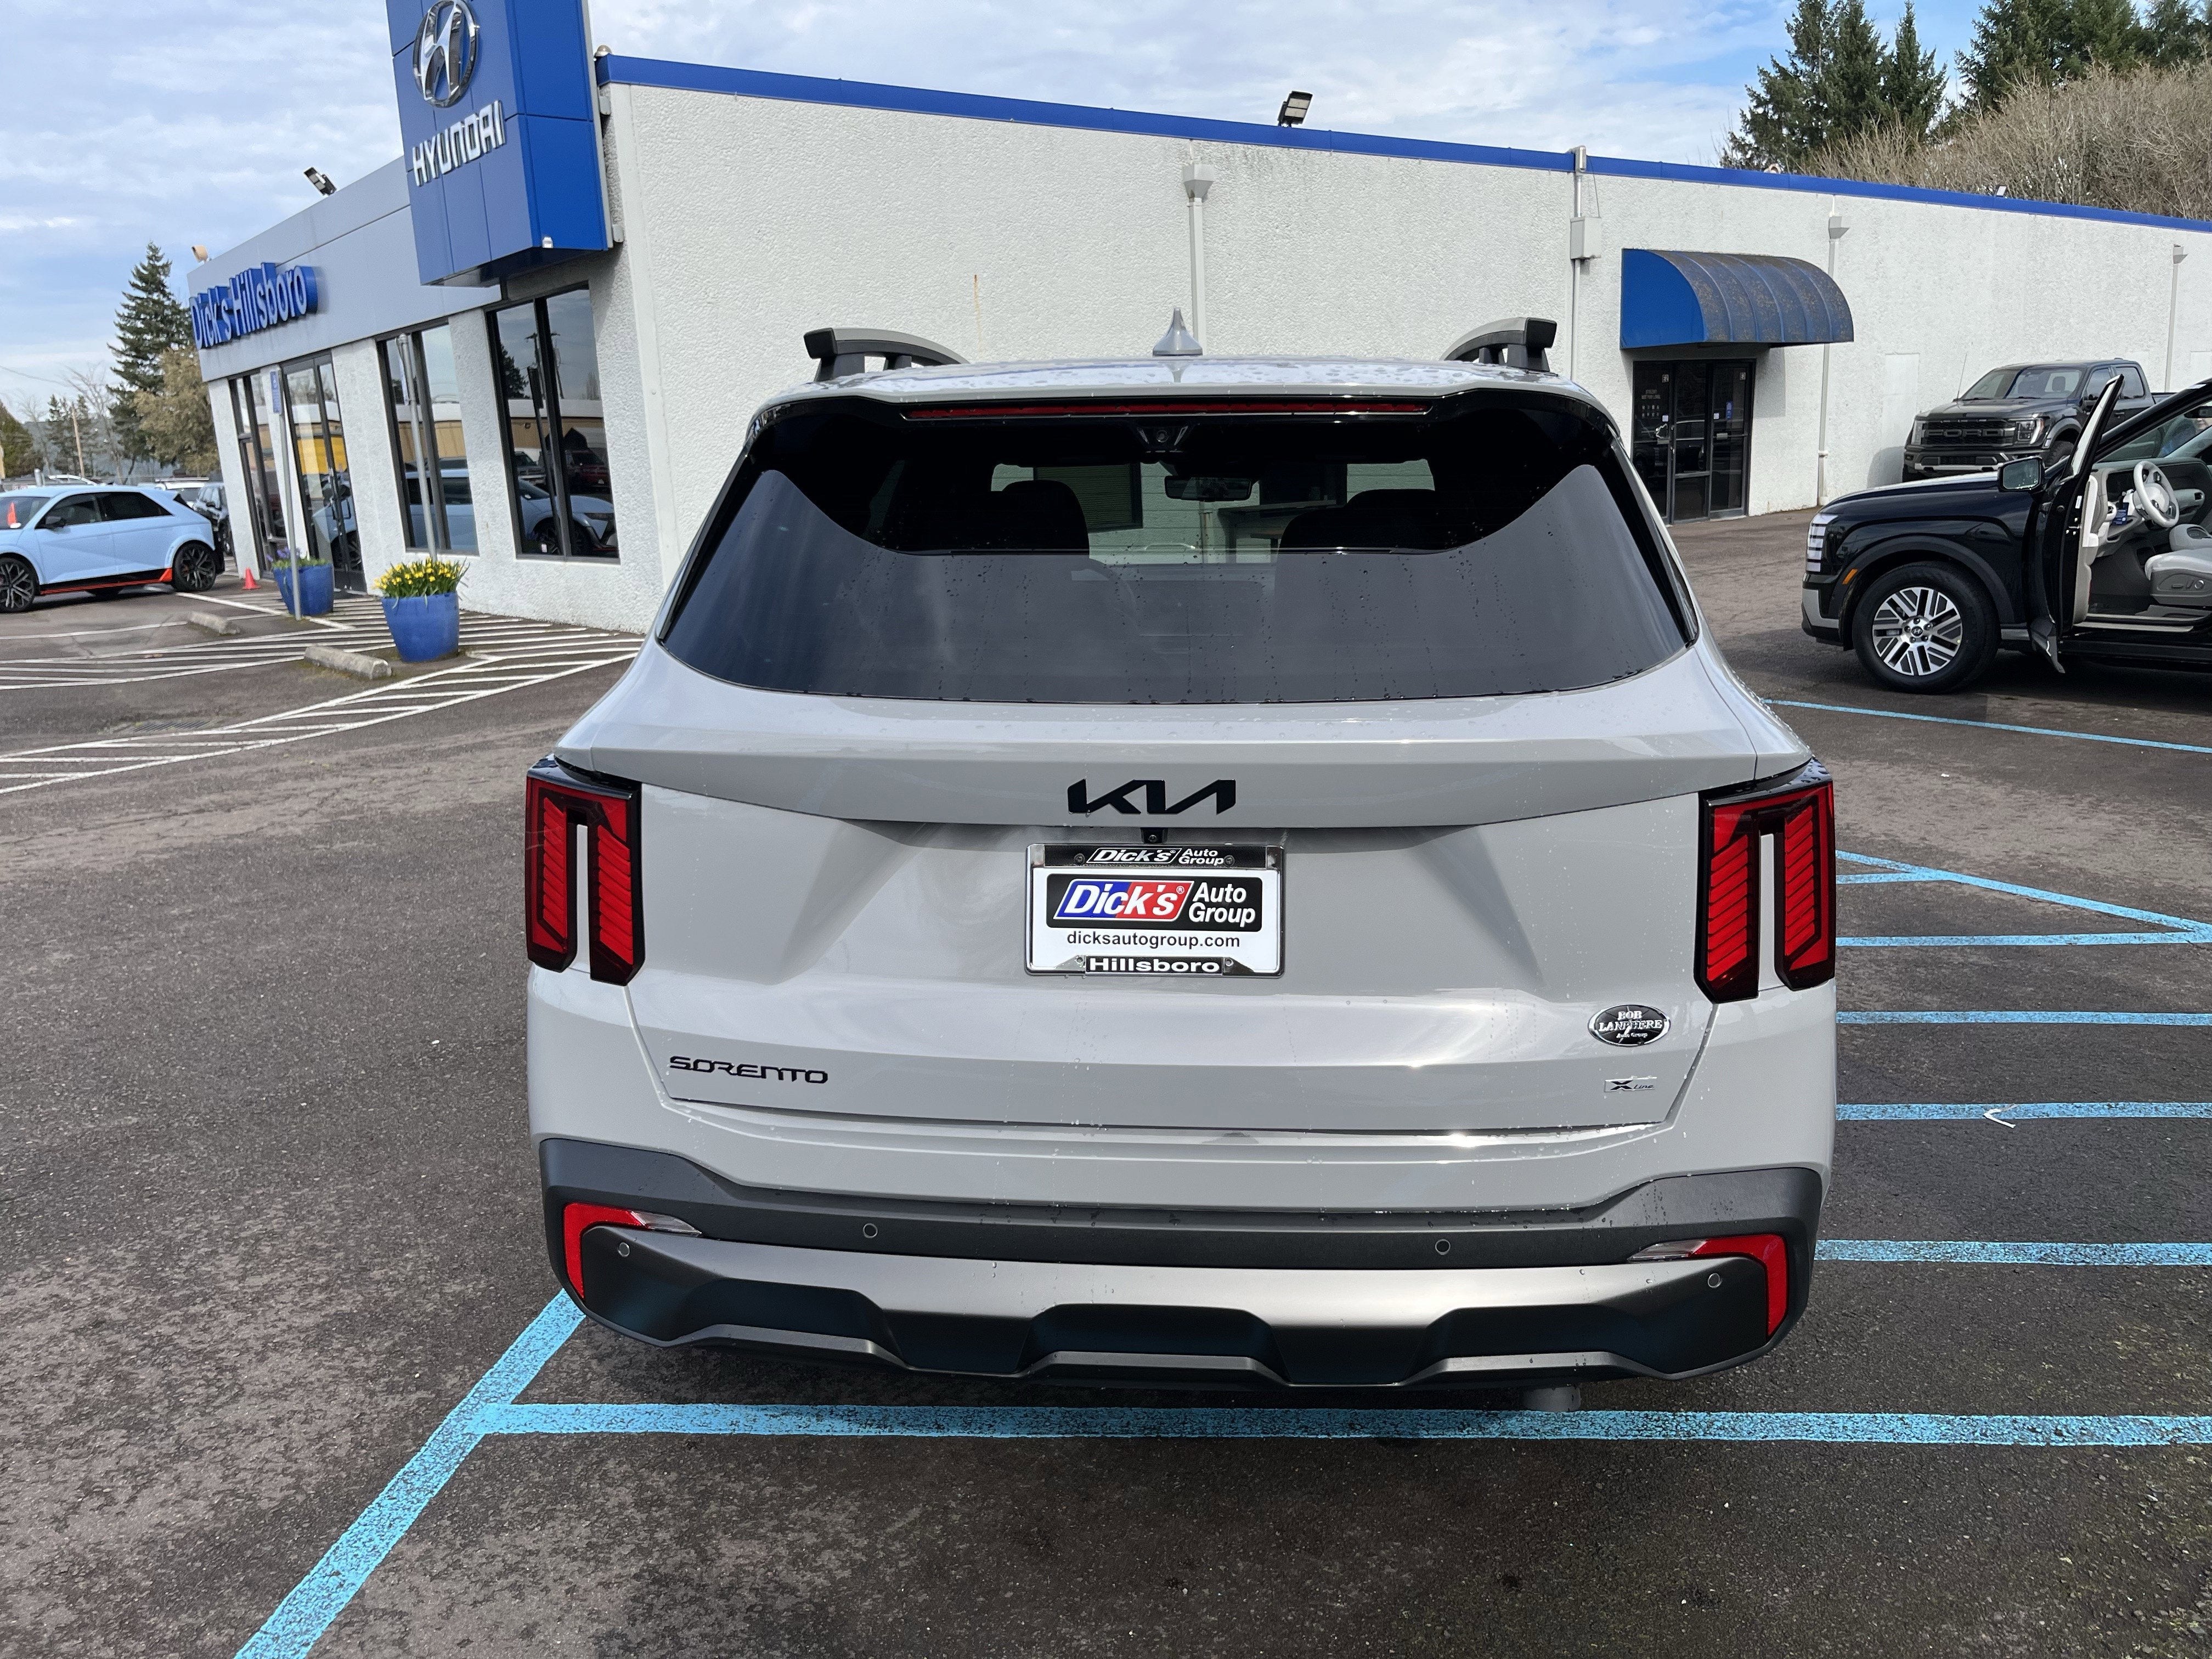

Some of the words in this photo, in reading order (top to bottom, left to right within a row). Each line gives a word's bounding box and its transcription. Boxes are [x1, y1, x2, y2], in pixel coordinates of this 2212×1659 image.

[412, 100, 506, 187] HYUNDAI
[189, 286, 232, 350] Dick's
[229, 262, 313, 336] Hillsboro
[1925, 428, 2004, 438] FORD
[1067, 778, 1236, 815] KIA
[1094, 849, 1173, 862] Dick's
[1182, 848, 1218, 857] Auto
[1178, 856, 1224, 866] Group
[1064, 883, 1180, 916] Dick's
[1192, 882, 1246, 903] Auto
[1188, 903, 1256, 928] Group
[1066, 930, 1240, 949] dicksautogroup.com
[1089, 957, 1221, 974] Hillsboro
[1617, 1011, 1643, 1020] BOB
[669, 1056, 828, 1084] SORENTO
